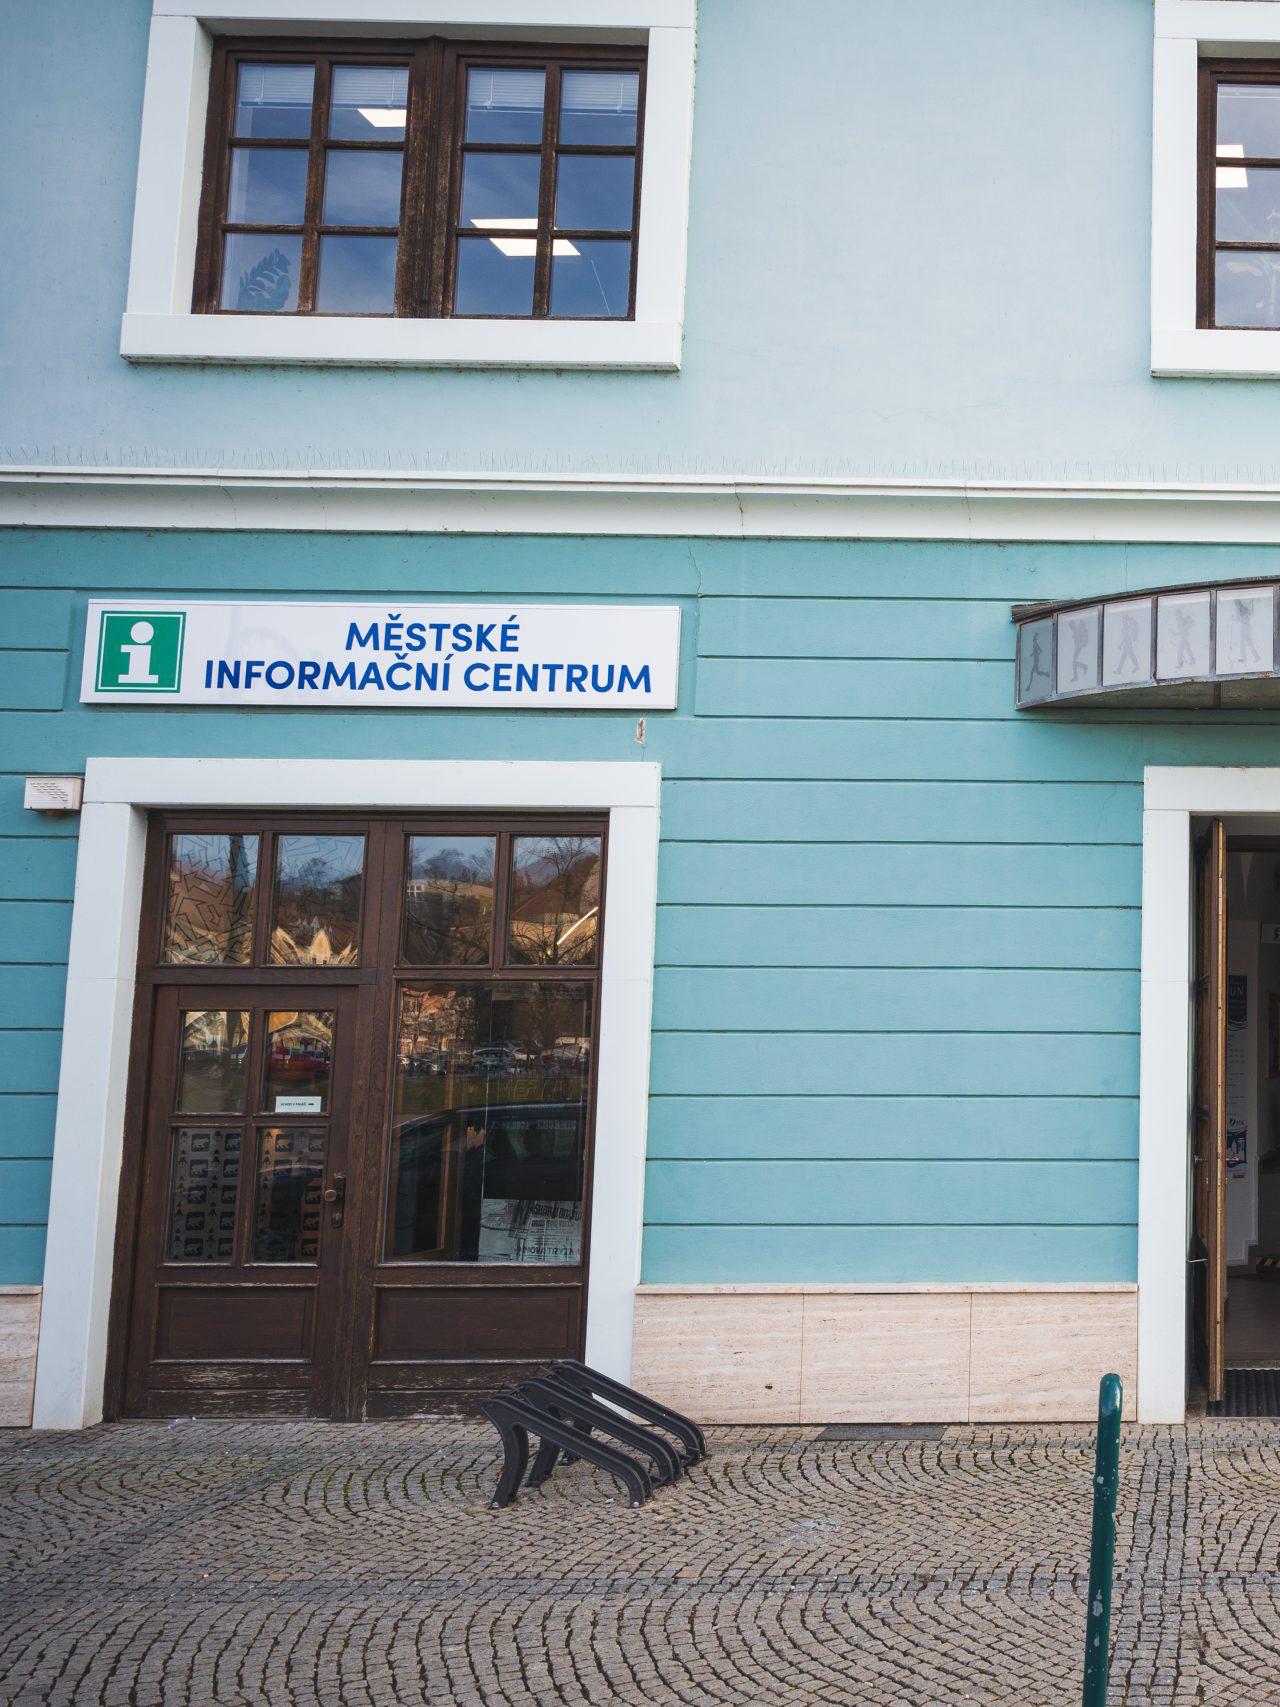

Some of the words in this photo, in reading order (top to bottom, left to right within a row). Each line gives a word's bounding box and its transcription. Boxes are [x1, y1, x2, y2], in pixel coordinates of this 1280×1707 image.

[345, 613, 521, 652] MĚSTSKÉ
[204, 653, 452, 692] INFORMAČNÍ
[464, 662, 652, 694] CENTRUM
